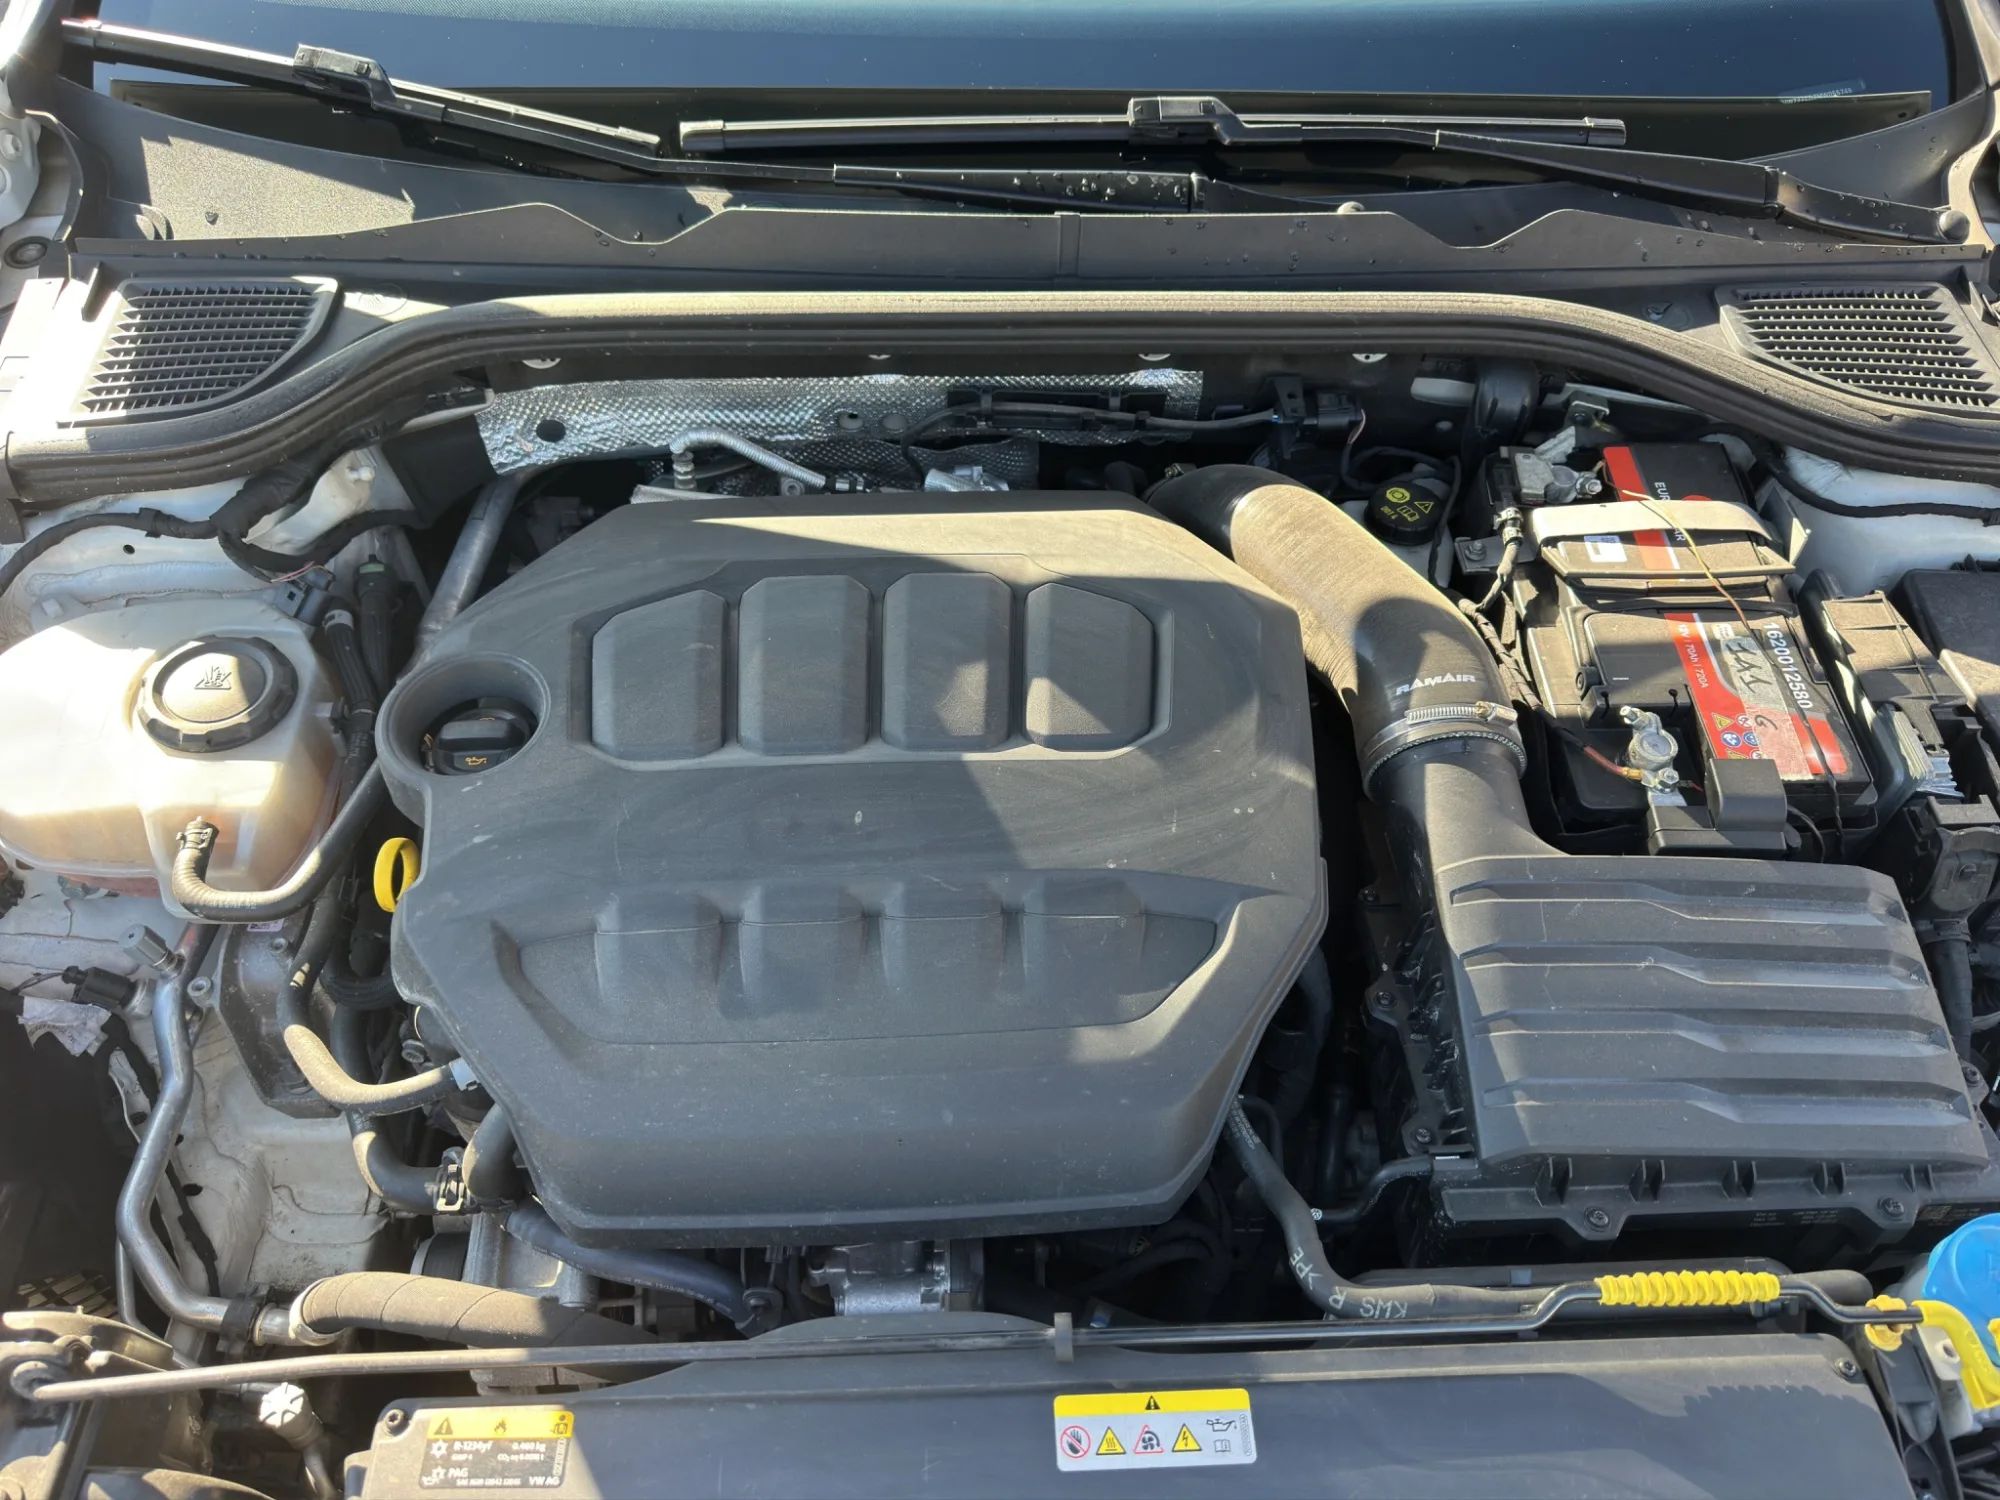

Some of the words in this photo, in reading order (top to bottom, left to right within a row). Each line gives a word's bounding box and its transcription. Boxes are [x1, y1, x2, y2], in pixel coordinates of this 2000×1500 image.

[1685, 643, 1699, 663] 70Ah
[1695, 668, 1709, 688] 720A
[1764, 622, 1813, 709] 1620012580
[1396, 672, 1476, 696] RAMAIR
[447, 1468, 469, 1478] PAG
[529, 1476, 545, 1485] VW
[545, 1476, 560, 1485] AG
